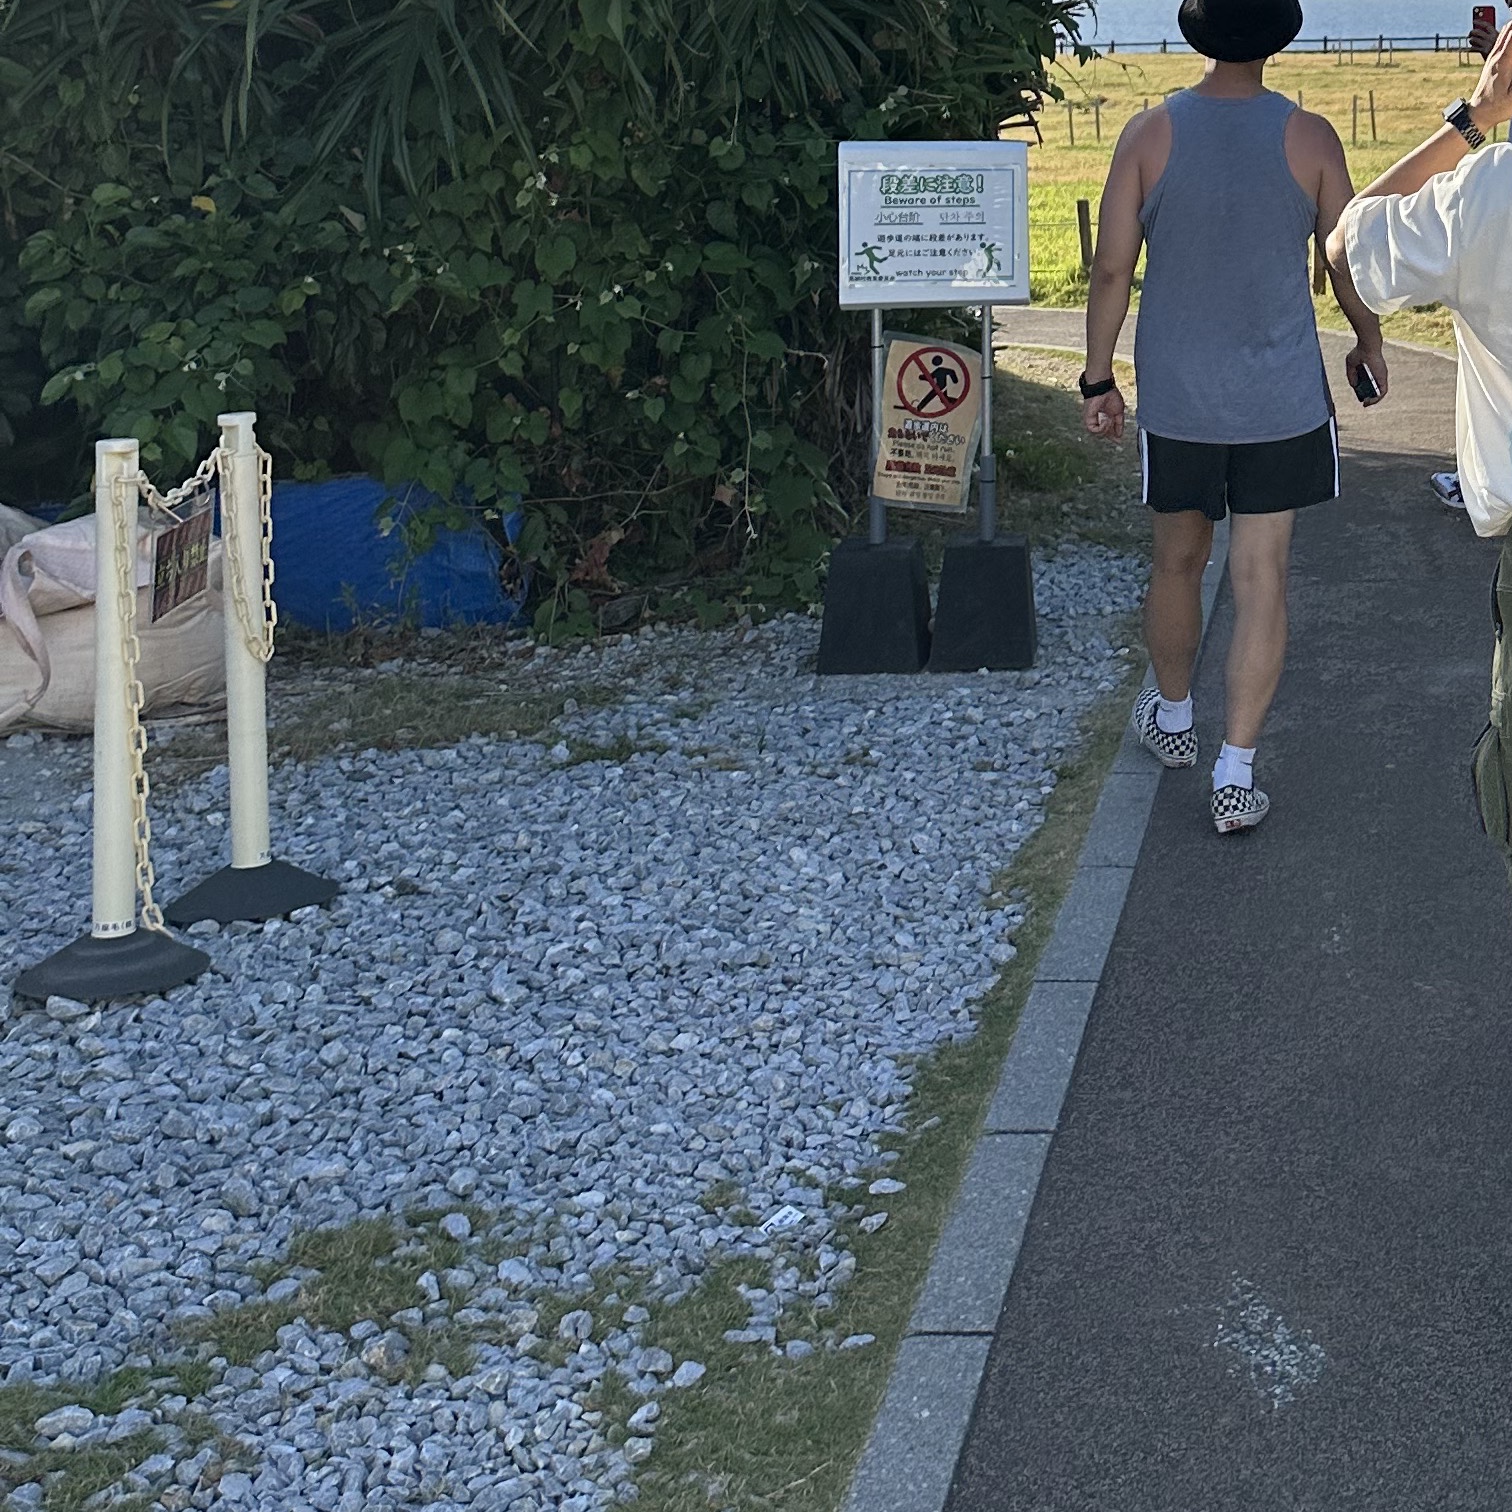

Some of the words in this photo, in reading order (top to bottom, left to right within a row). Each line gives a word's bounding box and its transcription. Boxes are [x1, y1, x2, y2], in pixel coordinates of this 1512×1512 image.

[884, 196, 926, 205] Beware
[930, 195, 941, 204] of
[945, 196, 976, 206] steps
[874, 211, 921, 223] 小心台阶
[895, 268, 923, 277] watch
[925, 269, 946, 278] your
